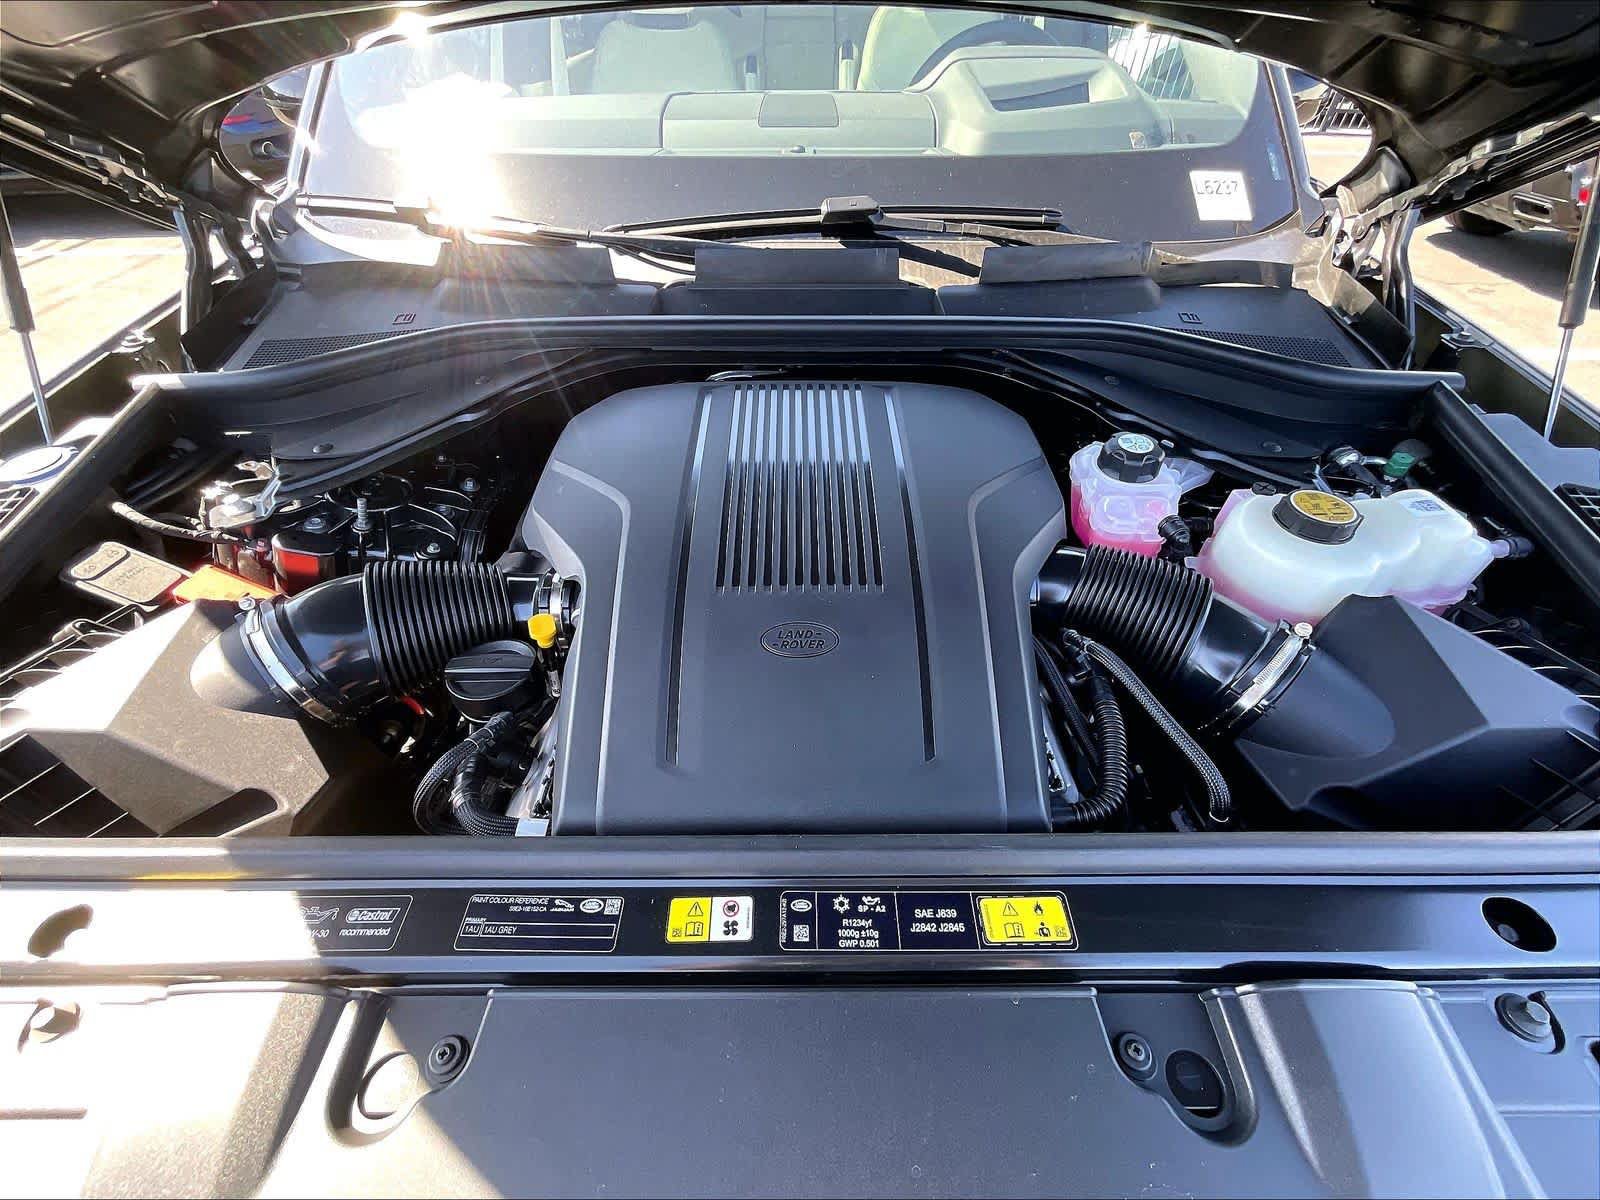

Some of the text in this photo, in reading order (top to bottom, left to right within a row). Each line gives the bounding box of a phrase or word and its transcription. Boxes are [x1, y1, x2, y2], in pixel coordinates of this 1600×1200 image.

[471, 896, 490, 904] PAINT
[514, 897, 550, 905] REFERENCE
[857, 905, 869, 913] SP
[875, 905, 887, 913] A2
[914, 909, 957, 918] SAE J839
[357, 909, 393, 921] Castrol
[842, 918, 872, 928] R1234yf
[339, 927, 391, 937] recommended
[465, 925, 518, 934] 1AU 1AU GREY
[910, 923, 965, 933] J2842 J2845
[837, 929, 879, 938] 1000g ±10g
[838, 939, 879, 947] GWP 0.501
